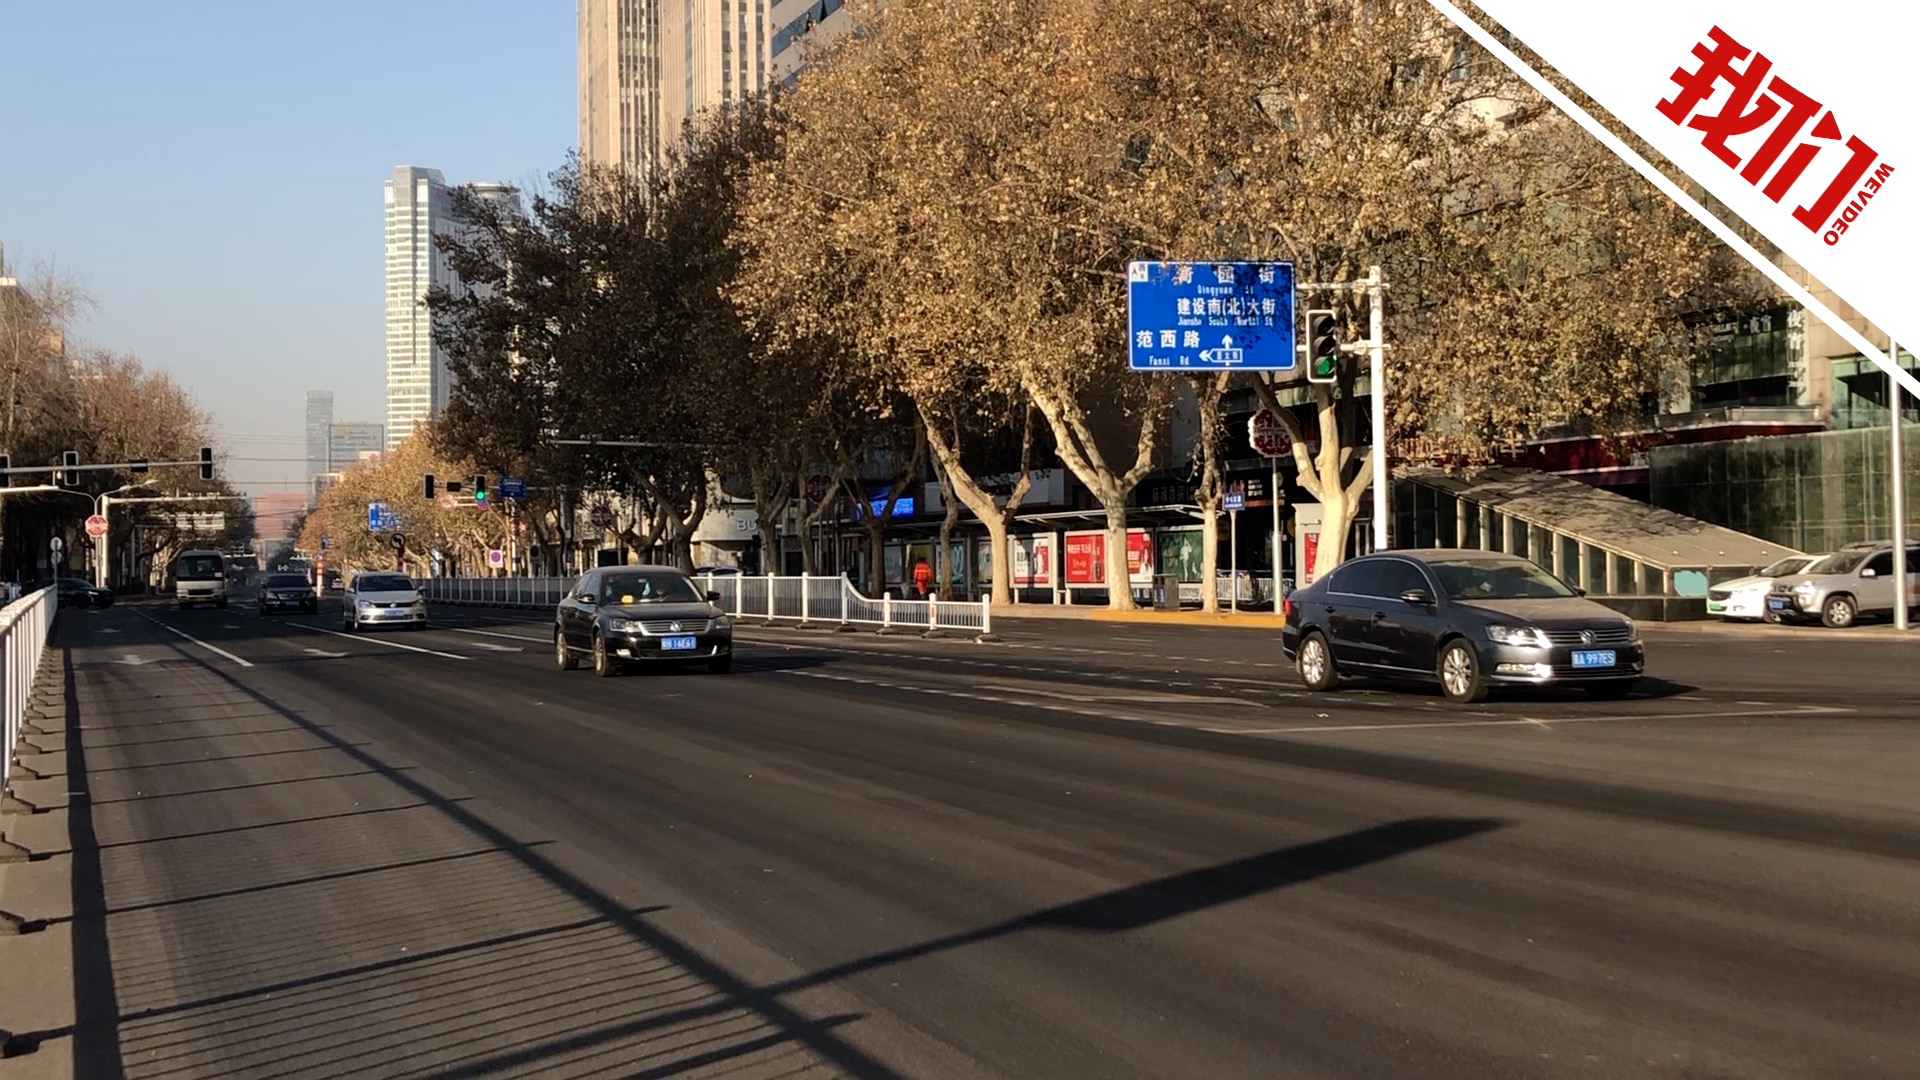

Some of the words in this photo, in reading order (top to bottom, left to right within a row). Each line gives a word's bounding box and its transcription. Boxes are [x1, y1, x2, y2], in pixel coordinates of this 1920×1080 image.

[1177, 297, 1275, 316] 建设南(北)大街
[1136, 330, 1199, 348] 范西路
